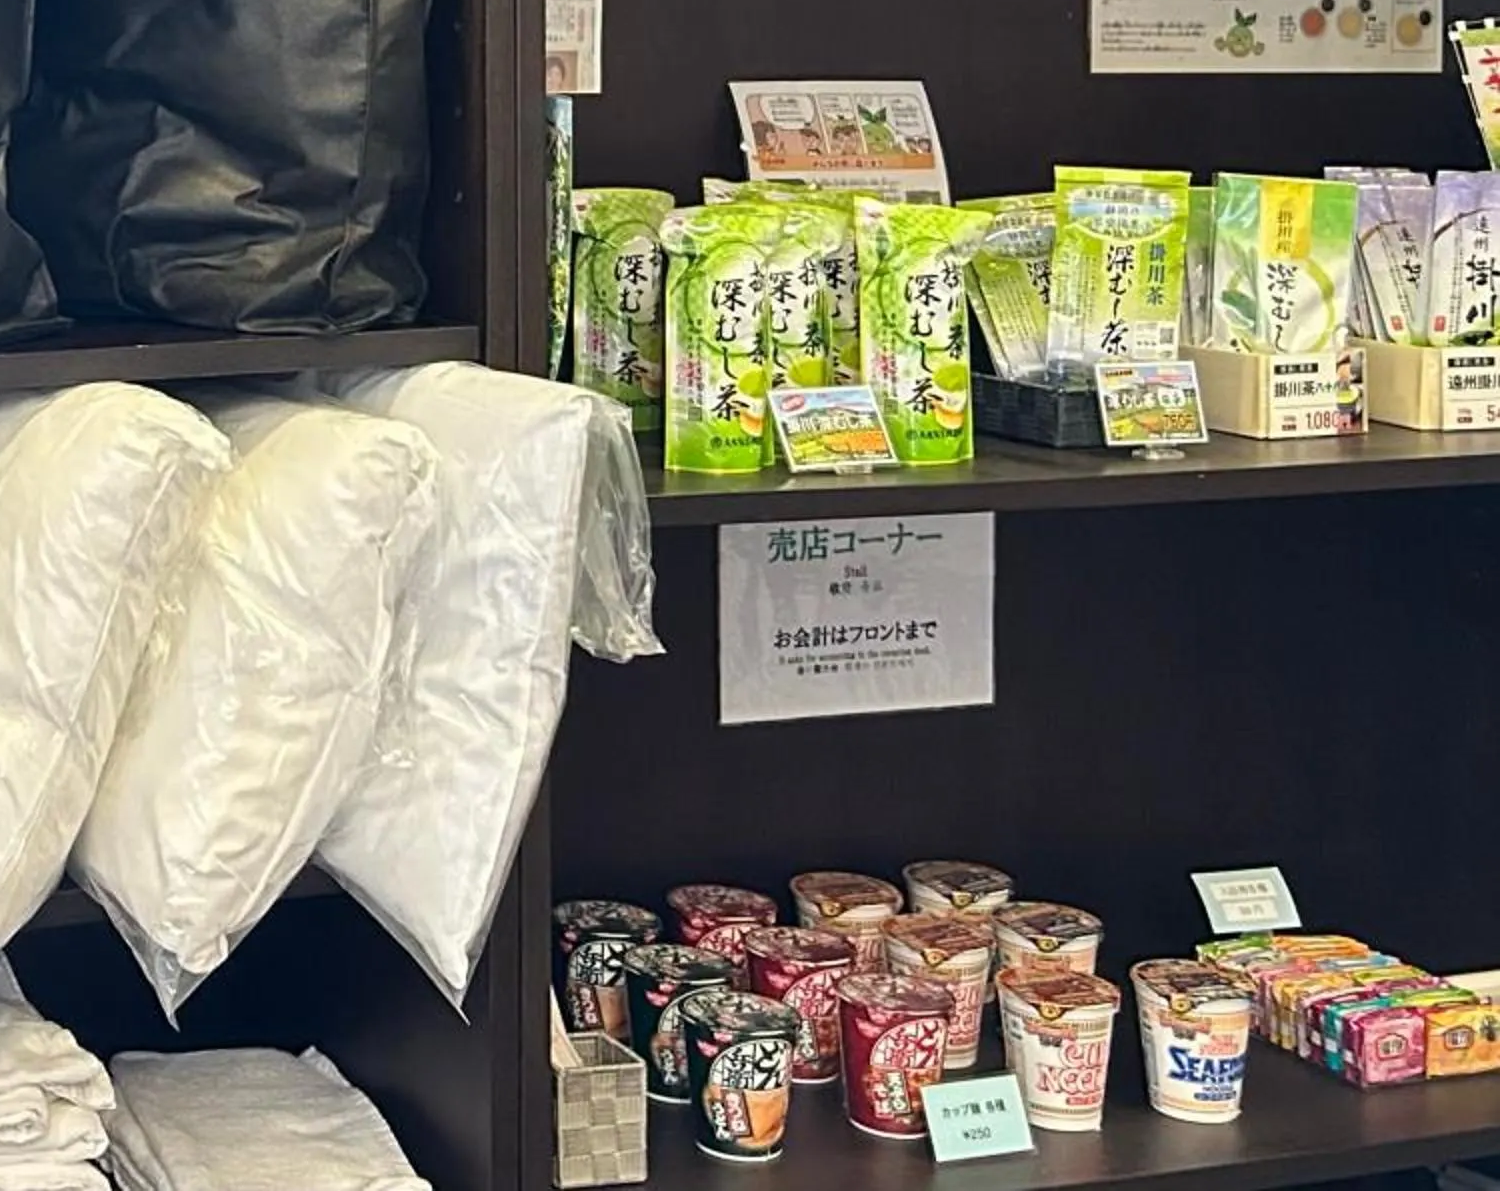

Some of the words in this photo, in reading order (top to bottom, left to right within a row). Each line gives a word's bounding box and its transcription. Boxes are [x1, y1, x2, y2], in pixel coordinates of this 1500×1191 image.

[768, 523, 943, 563] 売店コーナー
[773, 620, 938, 649] お会計はフロントまで
